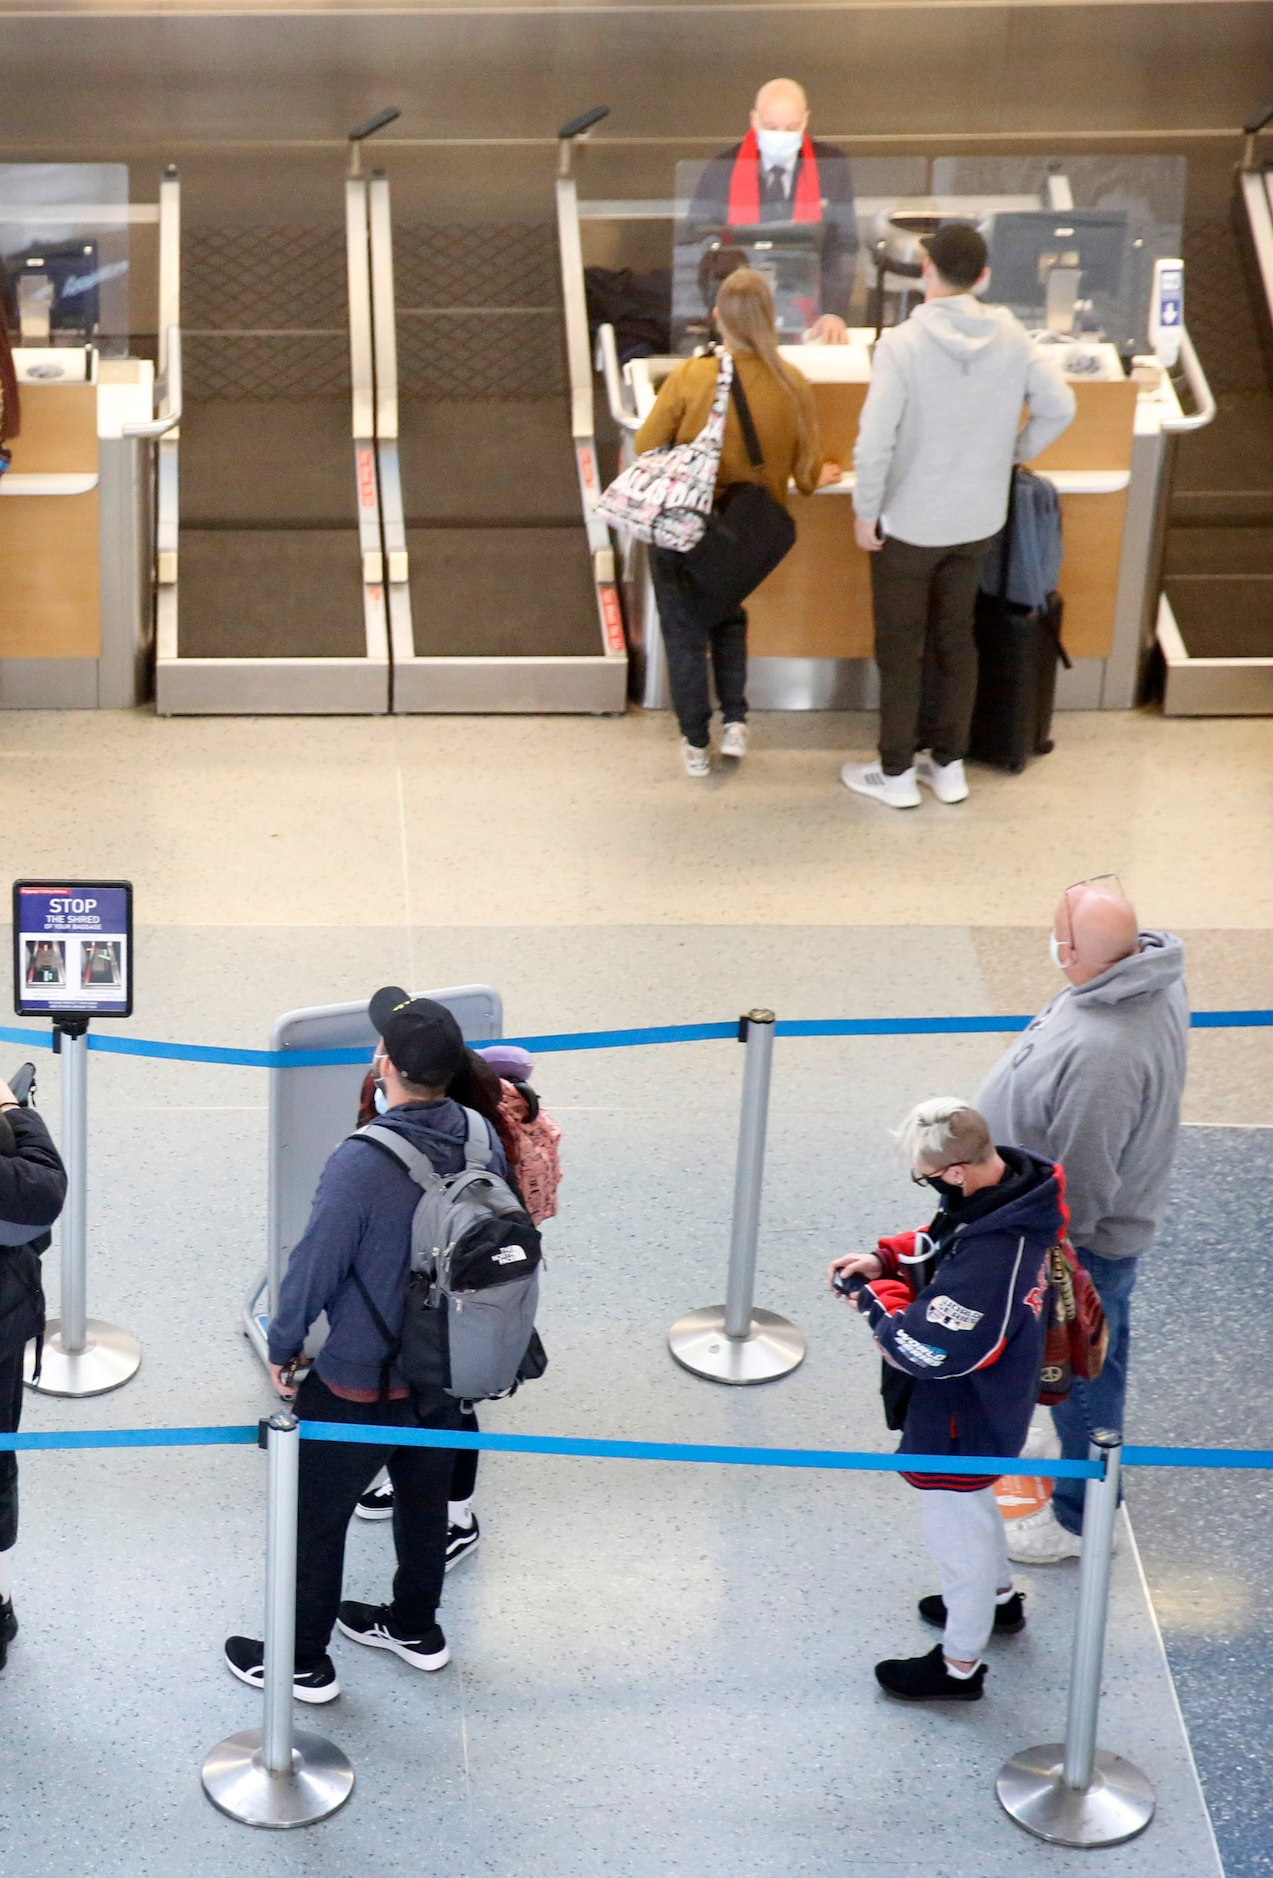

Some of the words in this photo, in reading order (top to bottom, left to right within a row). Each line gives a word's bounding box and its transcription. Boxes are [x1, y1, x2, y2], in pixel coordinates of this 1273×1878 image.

[49, 898, 98, 914] STOP
[45, 915, 65, 924] THE
[67, 915, 100, 924] SHRED
[72, 923, 102, 931] BAGGAGE
[896, 1328, 947, 1361] WORLD
